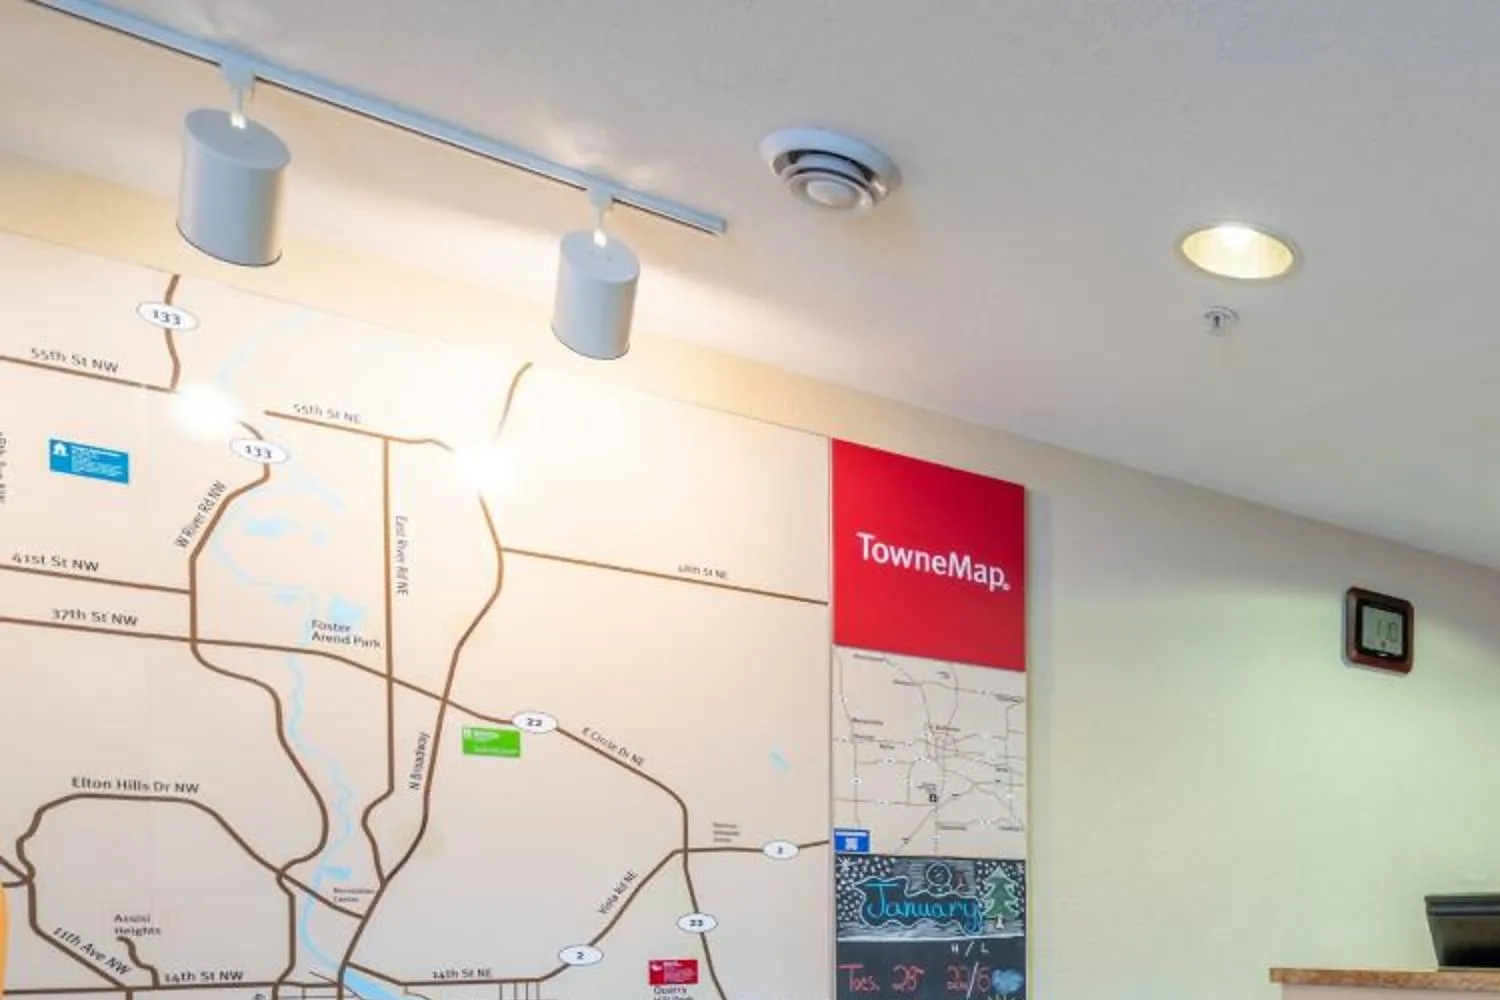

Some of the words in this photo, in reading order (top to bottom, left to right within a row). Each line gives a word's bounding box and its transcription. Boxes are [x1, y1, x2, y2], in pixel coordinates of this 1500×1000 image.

[151, 309, 182, 327] 133
[31, 347, 67, 362] 55th
[71, 353, 87, 368] St
[91, 359, 119, 373] NW
[244, 443, 274, 461] 133
[207, 479, 227, 499] NW
[11, 552, 46, 566] 41st
[50, 555, 68, 568] St
[71, 558, 100, 573] NW
[51, 608, 87, 622] 37th
[91, 610, 107, 623] St
[111, 613, 139, 628] NW
[311, 619, 351, 633] Foster
[71, 776, 112, 789] Elton
[116, 779, 150, 792] Hills
[153, 781, 170, 792] Dr
[174, 782, 201, 794] NW
[863, 882, 981, 935] January
[104, 956, 133, 975] NW
[476, 968, 492, 978] NE
[200, 971, 215, 982] St
[218, 970, 245, 982] NW
